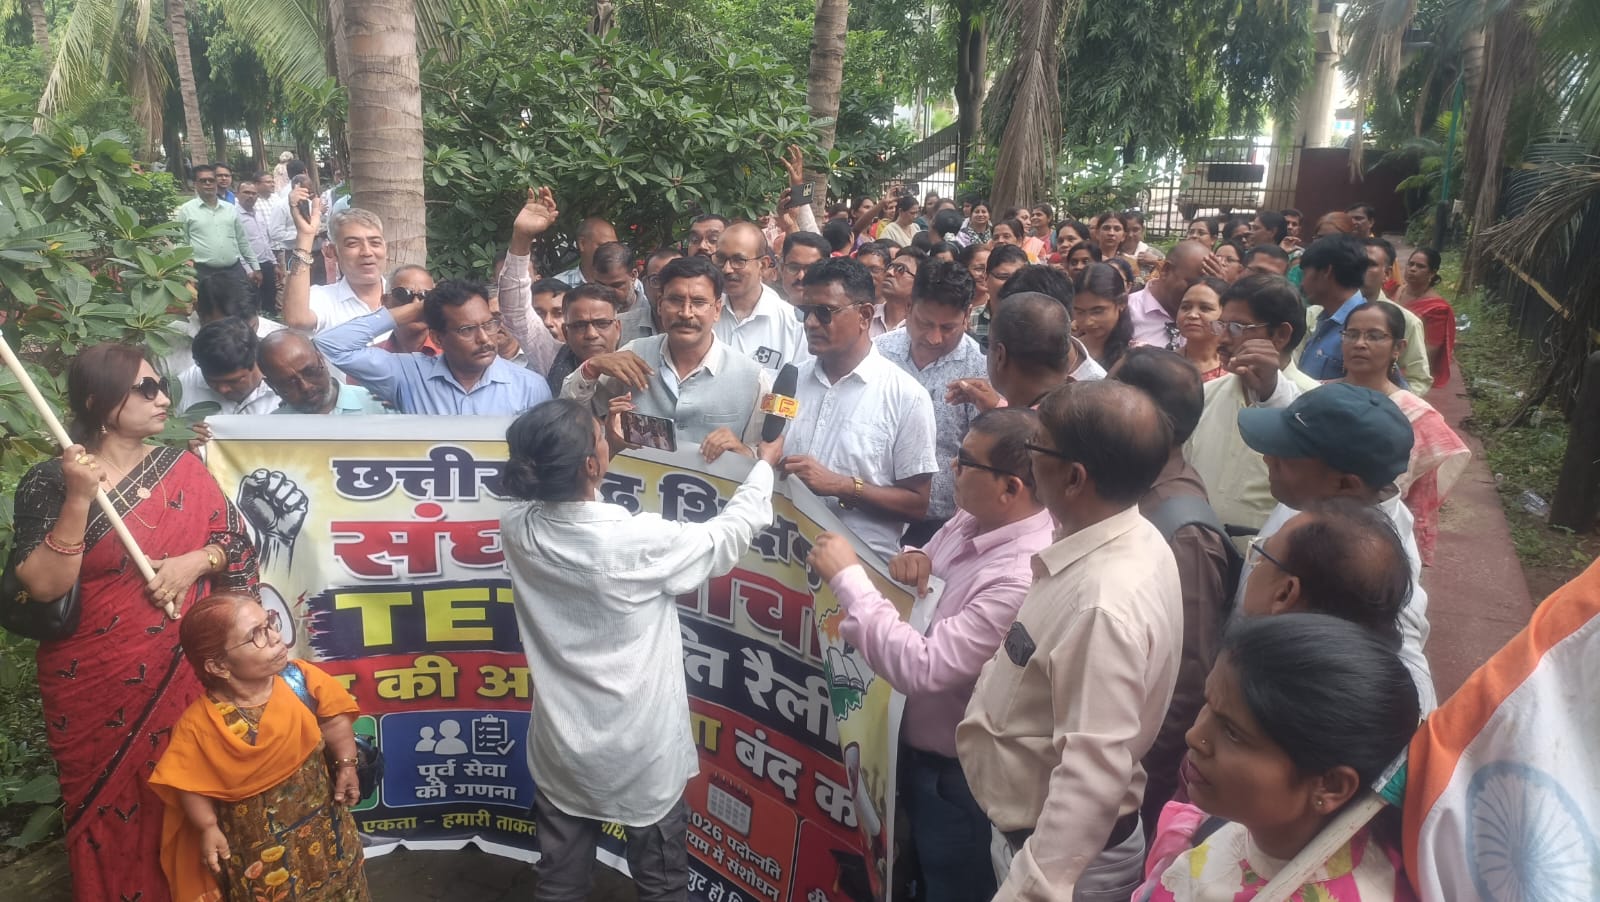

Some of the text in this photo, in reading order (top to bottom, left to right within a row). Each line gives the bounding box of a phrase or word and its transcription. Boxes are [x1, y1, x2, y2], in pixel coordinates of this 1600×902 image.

[334, 588, 516, 647] TE
[374, 655, 459, 700] की
[734, 728, 802, 801] बंद
[417, 759, 507, 784] पूर्व सेवा
[454, 783, 517, 800] गणना
[362, 815, 417, 833] एकता
[441, 809, 490, 830] हमारी
[688, 812, 781, 881] 026 पदोन्नति
[726, 856, 780, 901] संशोधन
